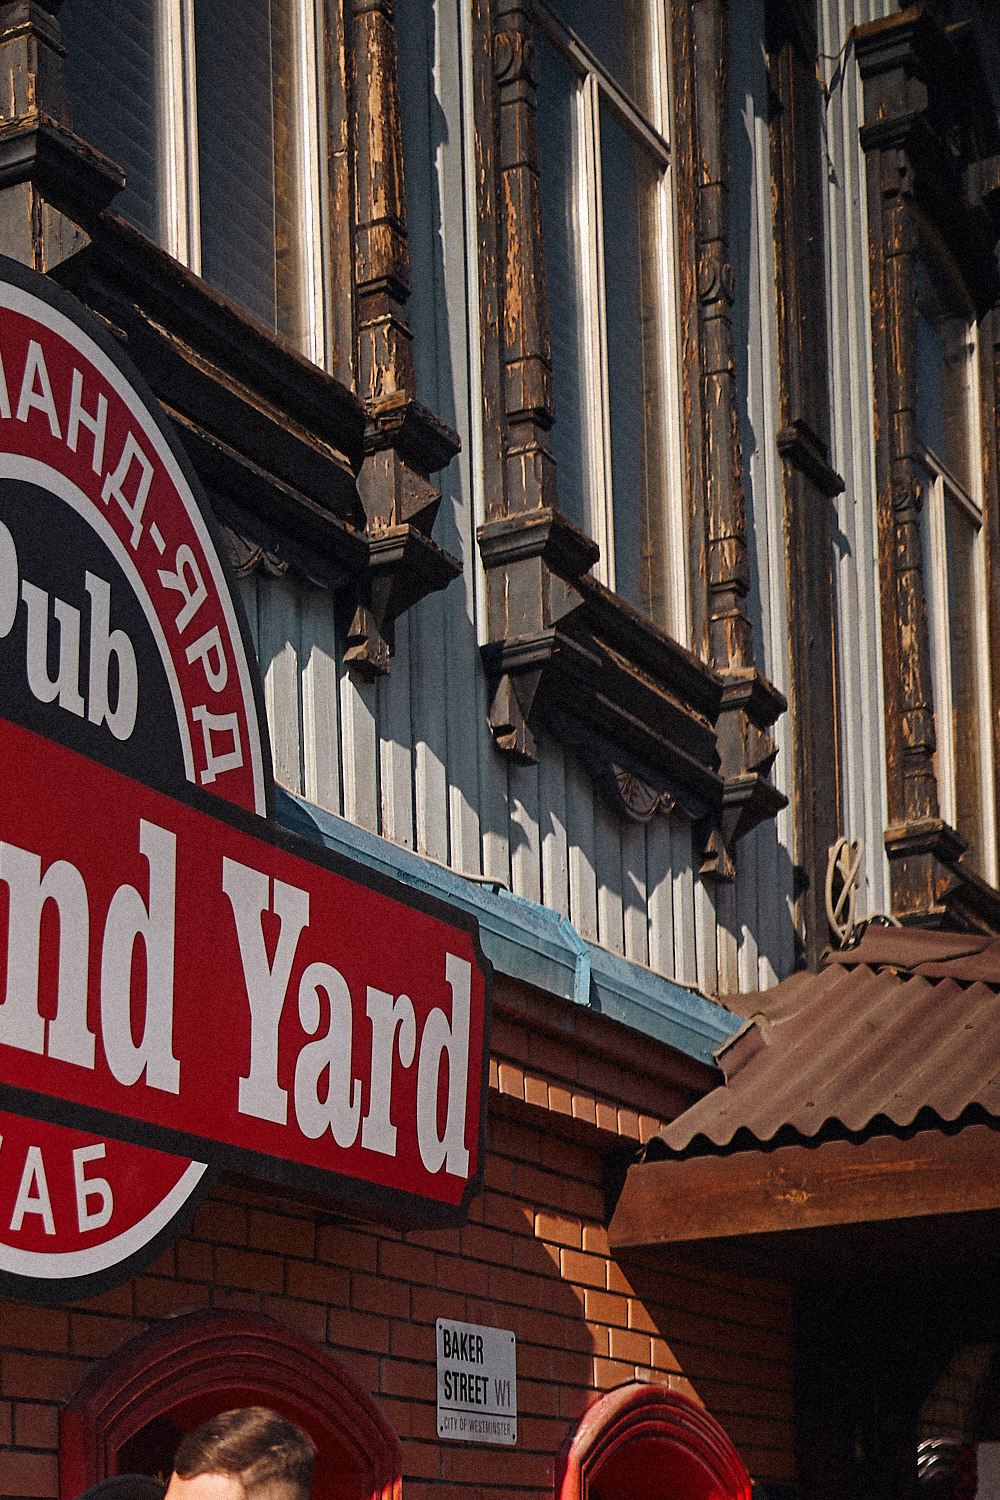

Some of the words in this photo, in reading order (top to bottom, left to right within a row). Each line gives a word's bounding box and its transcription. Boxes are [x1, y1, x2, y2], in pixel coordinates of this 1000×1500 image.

[222, 856, 472, 1179] Yard
[443, 1329, 484, 1365] BAKER
[444, 1370, 489, 1406] STREET
[495, 1378, 511, 1408] W1
[444, 1416, 458, 1431] CITY
[460, 1418, 468, 1432] OF
[469, 1420, 512, 1436] WESTMINSTER
